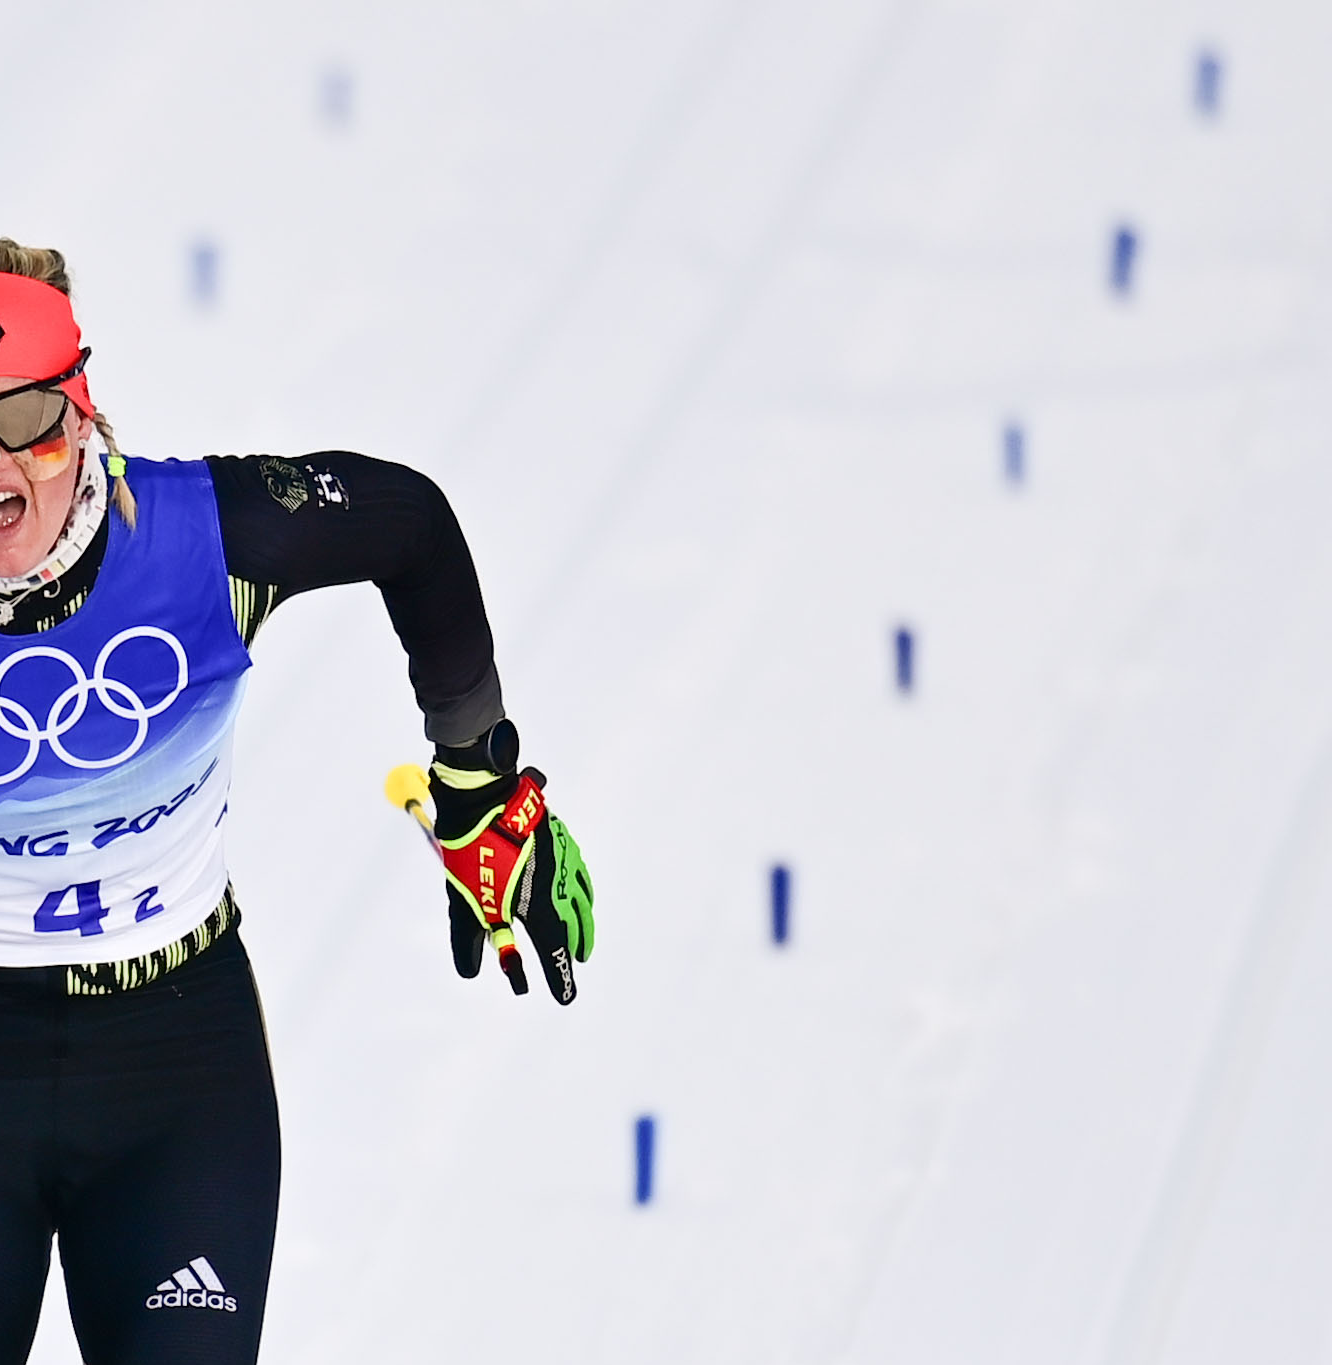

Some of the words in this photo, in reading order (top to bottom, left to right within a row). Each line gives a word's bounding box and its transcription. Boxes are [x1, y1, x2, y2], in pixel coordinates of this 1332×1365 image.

[507, 786, 541, 834] LEK
[479, 845, 499, 915] LEKI
[33, 879, 110, 937] 4
[132, 885, 165, 923] 2
[551, 947, 572, 1002] Roeckl
[145, 1288, 238, 1313] adidas
